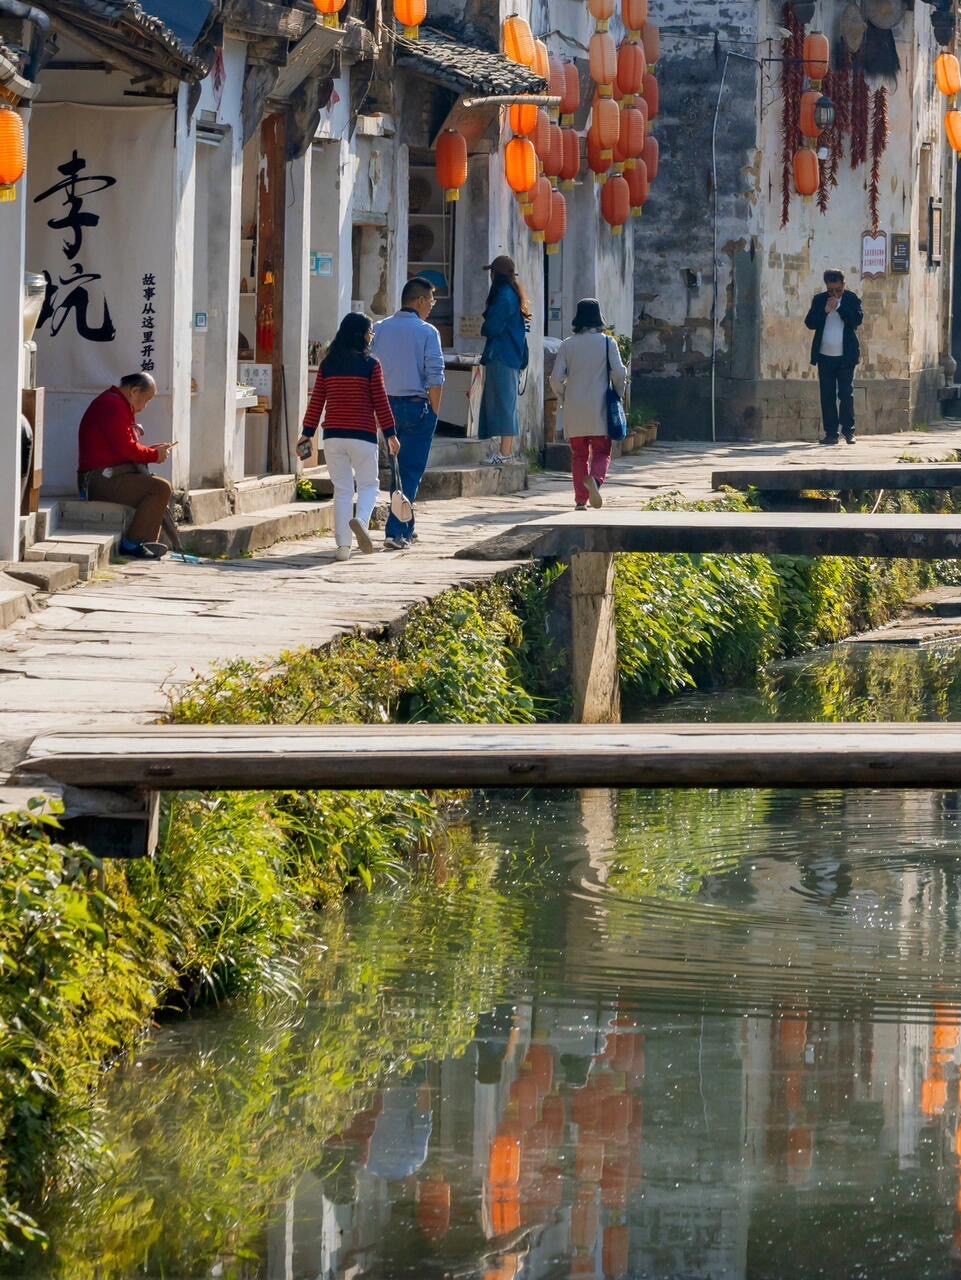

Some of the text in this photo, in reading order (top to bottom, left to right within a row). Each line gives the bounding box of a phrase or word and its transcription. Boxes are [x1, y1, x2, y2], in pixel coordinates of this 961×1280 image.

[140, 273, 156, 372] 故事从这里开始
